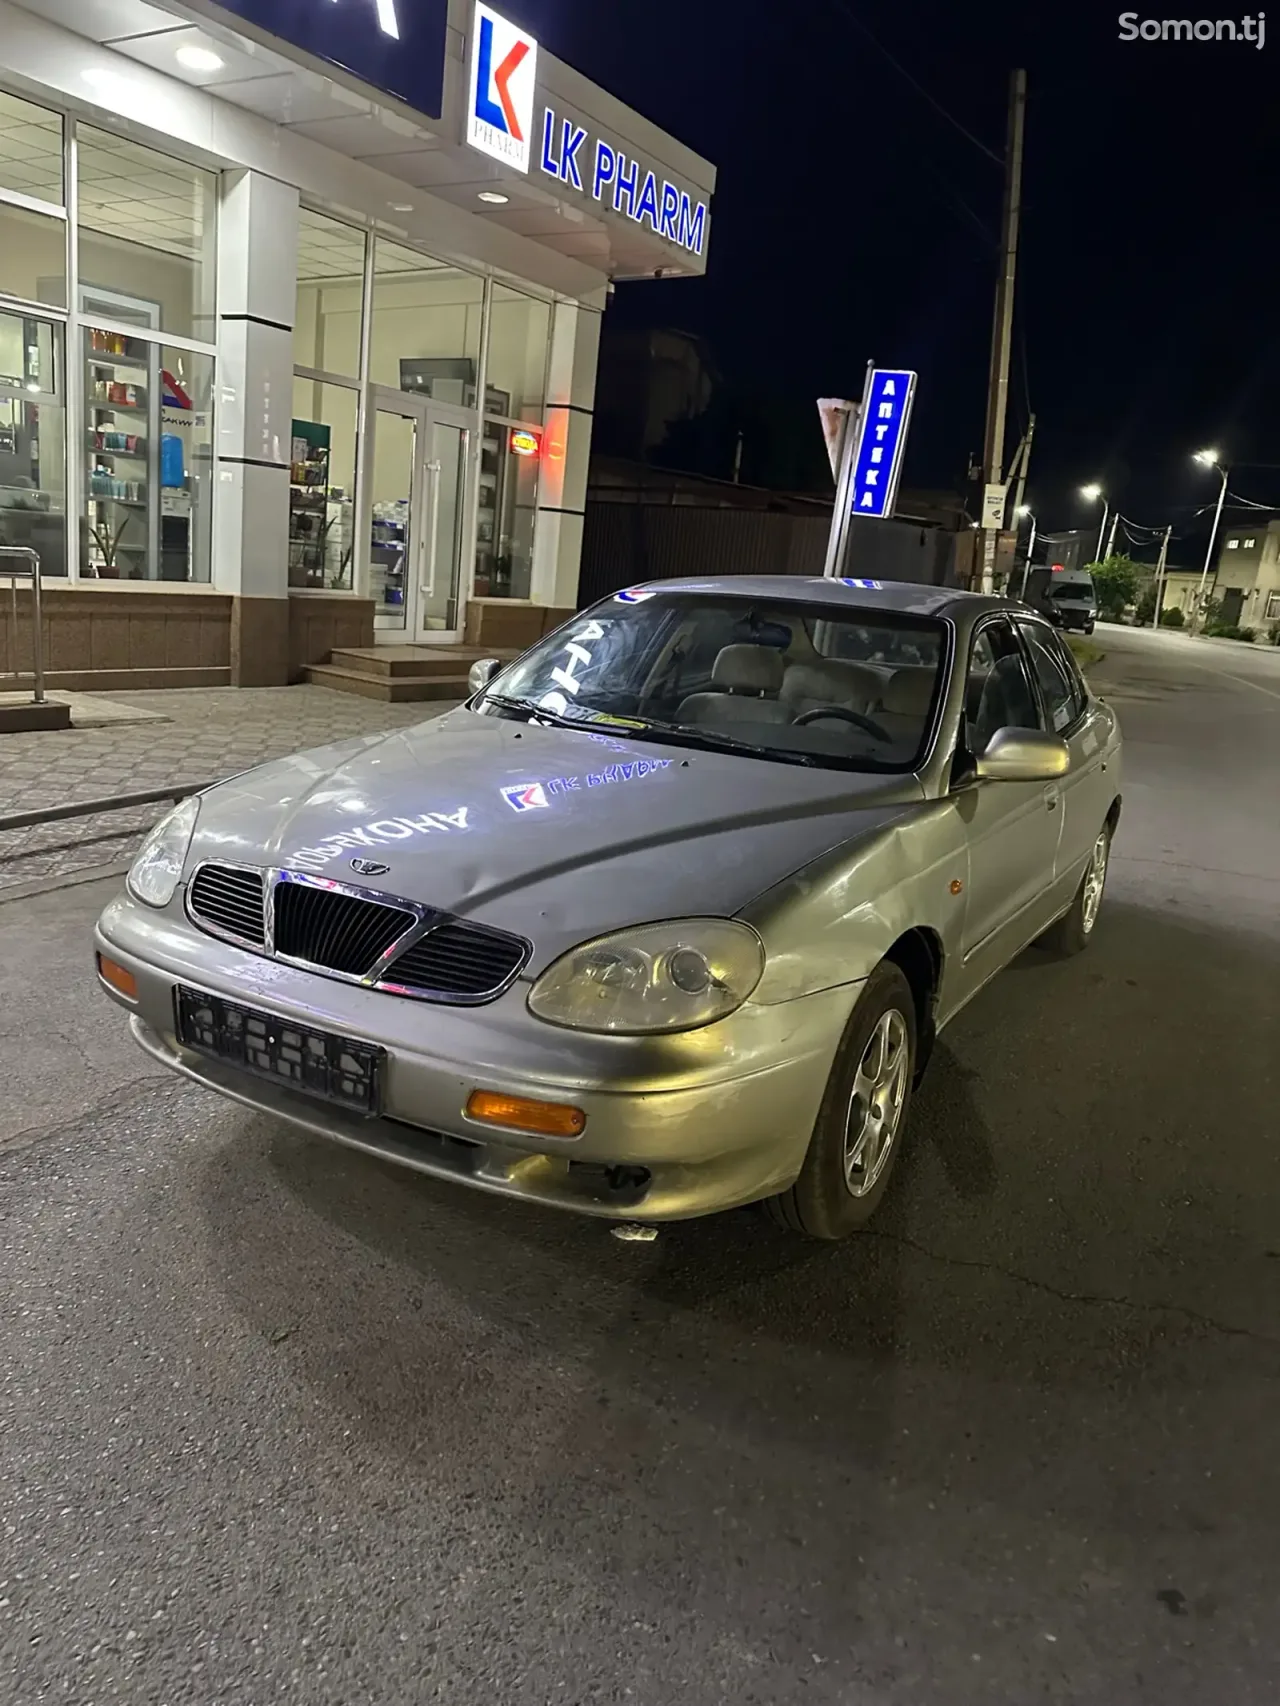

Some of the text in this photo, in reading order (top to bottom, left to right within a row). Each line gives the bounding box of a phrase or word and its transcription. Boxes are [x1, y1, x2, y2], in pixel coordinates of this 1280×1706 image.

[474, 120, 524, 161] PHARM
[540, 106, 707, 256] LK PHARM
[860, 379, 896, 508] АПТЕКА
